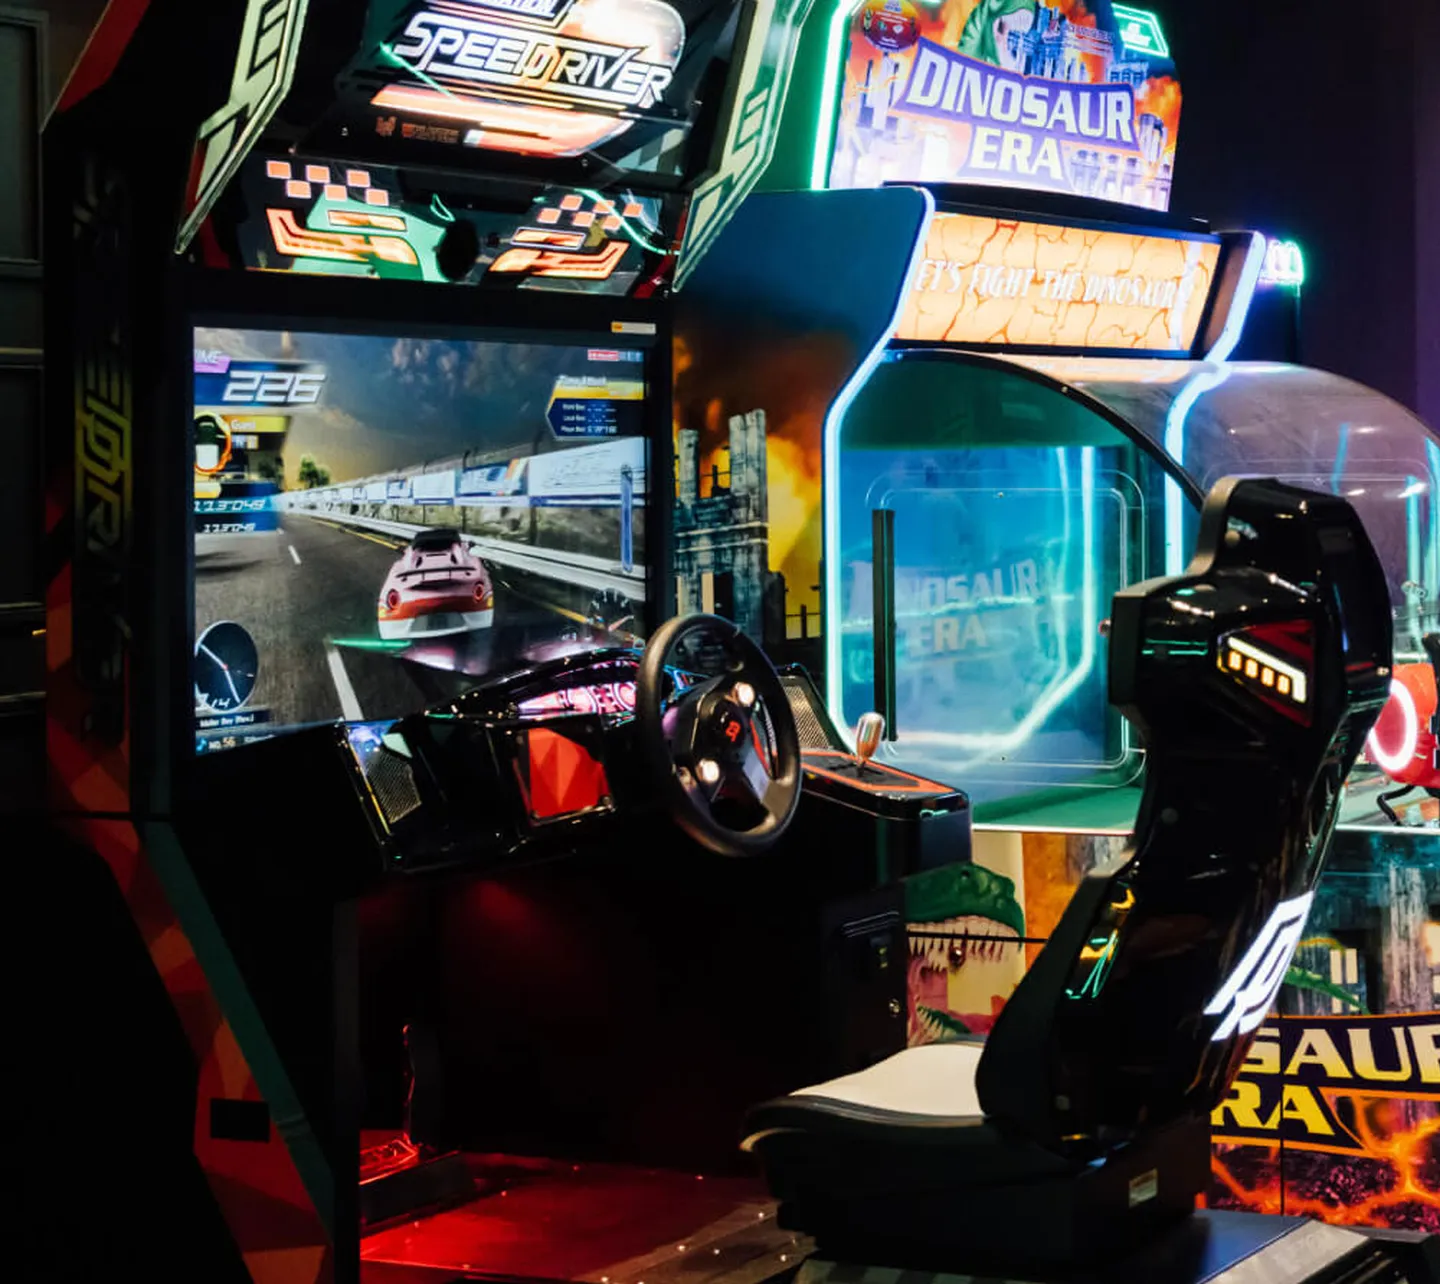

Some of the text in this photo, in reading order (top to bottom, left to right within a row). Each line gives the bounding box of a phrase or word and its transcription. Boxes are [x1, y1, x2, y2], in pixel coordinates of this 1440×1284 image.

[906, 47, 1134, 143] DINOSAUR
[972, 127, 1064, 180] ERA
[914, 259, 965, 294] ET'S
[967, 262, 1037, 298] FIGHT
[1039, 268, 1083, 302] THE
[195, 350, 222, 364] IME
[223, 370, 326, 403] 226
[850, 558, 1038, 621] DNOSAUR
[910, 614, 990, 655] ERA
[1212, 1080, 1335, 1136] RA
